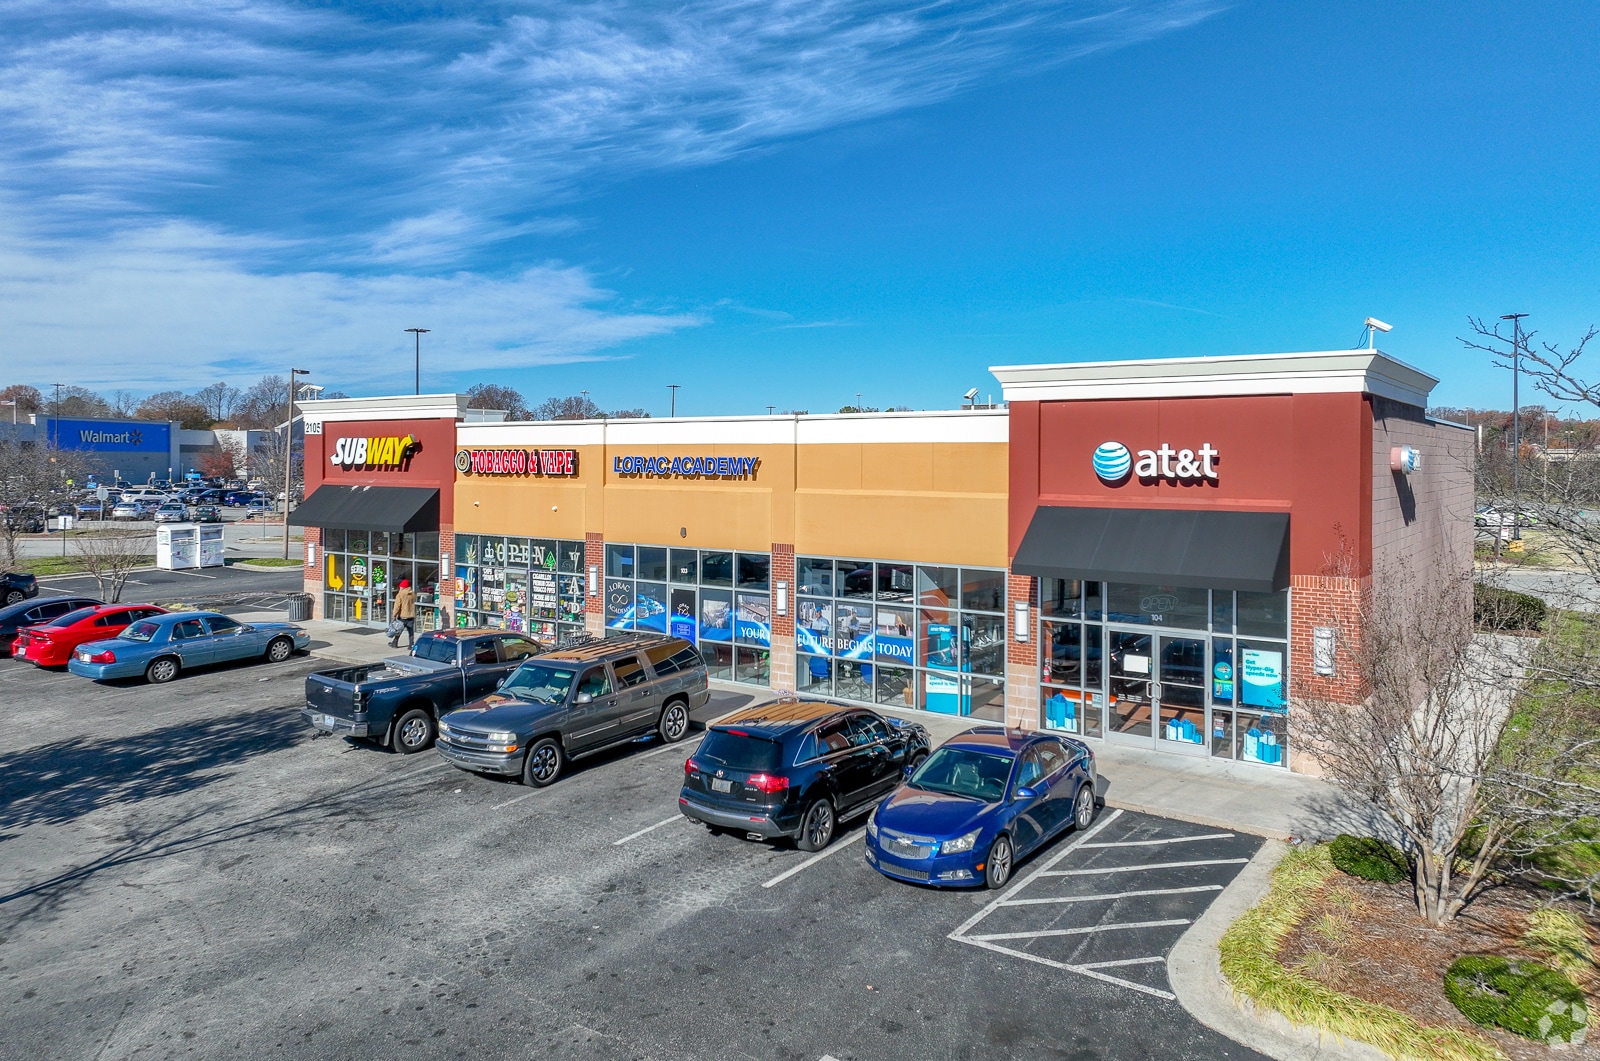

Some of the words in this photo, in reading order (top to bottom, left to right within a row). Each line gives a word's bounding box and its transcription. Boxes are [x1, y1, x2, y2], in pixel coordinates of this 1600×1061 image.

[305, 422, 321, 433] 2105
[80, 430, 130, 443] Walmart
[330, 434, 415, 466] SUBWAY
[470, 450, 525, 473] TOBACCO
[527, 450, 538, 474] &
[540, 450, 573, 475] VAPE
[613, 456, 667, 474] LORAC
[669, 456, 757, 475] ACADEMY
[1134, 442, 1218, 478] at&t
[496, 543, 546, 565] OPEN
[608, 581, 631, 593] LORAC
[608, 603, 631, 614] ACADEMY
[1141, 596, 1176, 610] OPEN
[1150, 614, 1163, 622] 104
[740, 627, 766, 640] YOUR
[797, 633, 834, 649] FUTURE
[837, 639, 873, 653] BEGINS
[878, 643, 913, 657] TODAY
[1245, 665, 1275, 673] Hyper-Gig
